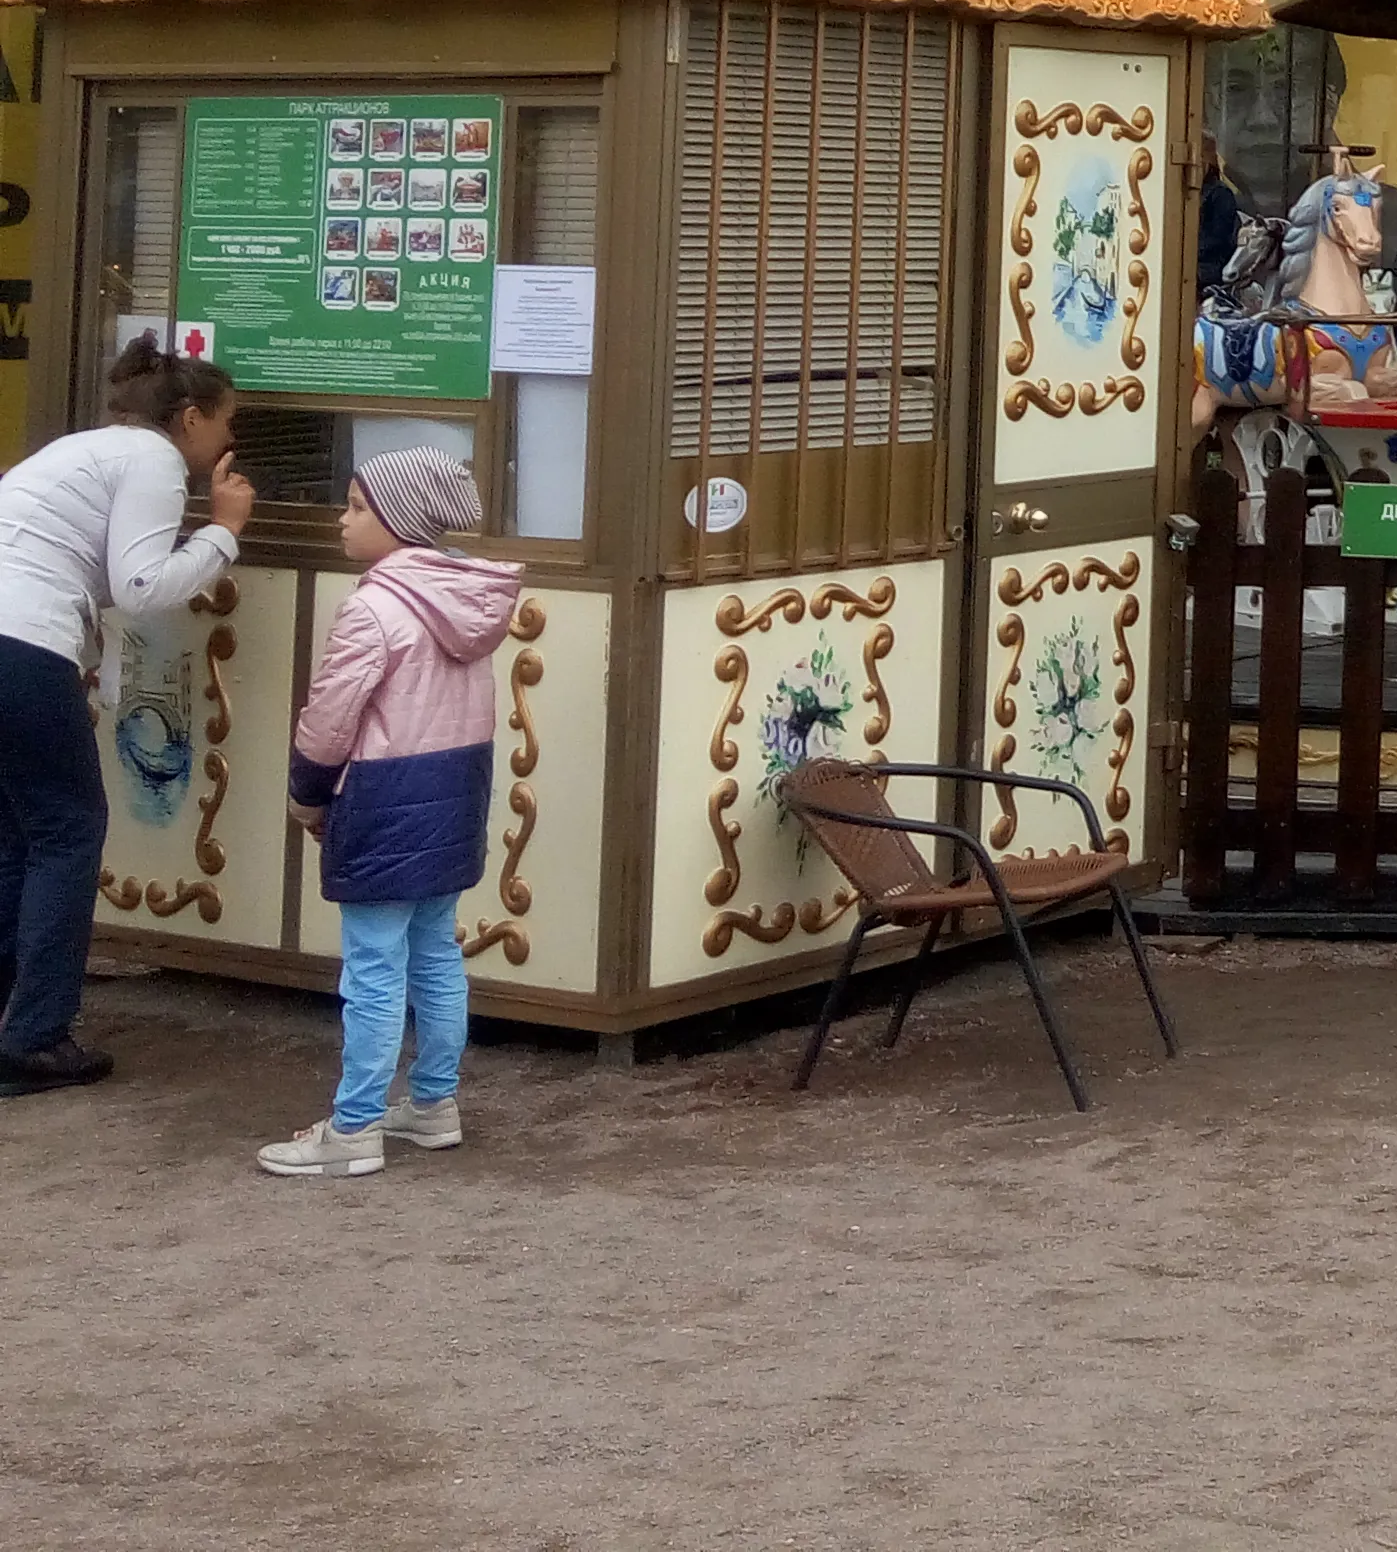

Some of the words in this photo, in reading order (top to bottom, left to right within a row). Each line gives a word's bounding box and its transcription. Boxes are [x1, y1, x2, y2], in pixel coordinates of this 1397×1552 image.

[289, 102, 314, 114] ПАРК
[315, 102, 390, 115] АТТРАКЦИОНОВ
[419, 273, 471, 290] АКЦИЯ
